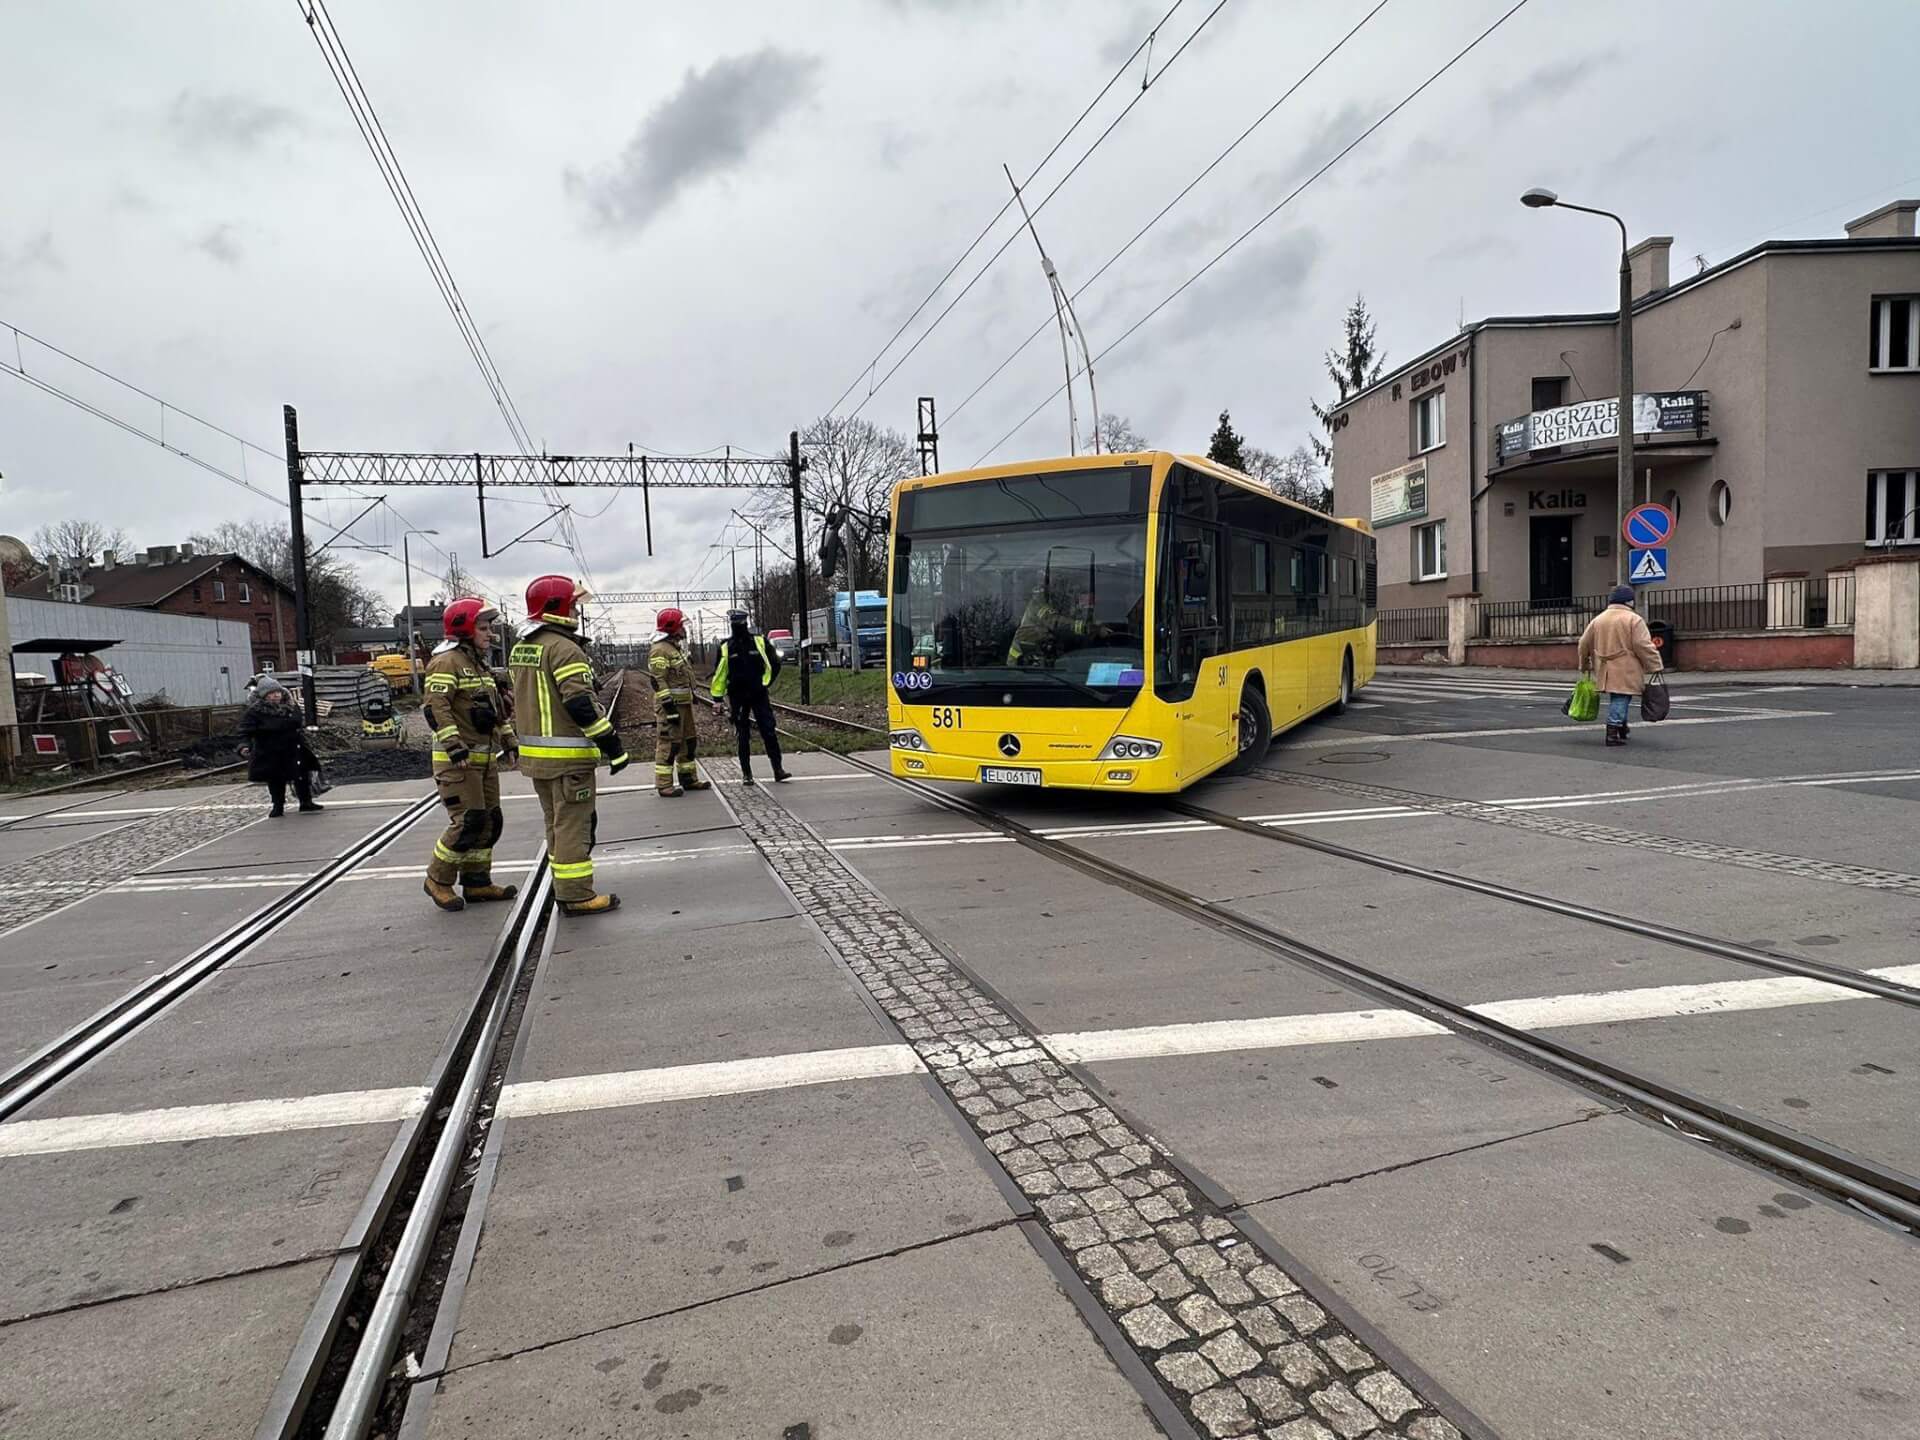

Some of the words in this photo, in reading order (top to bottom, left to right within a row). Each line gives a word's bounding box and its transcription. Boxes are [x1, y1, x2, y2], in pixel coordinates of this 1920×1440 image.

[1660, 395, 1695, 408] Kalia
[1532, 401, 1619, 431] POGRZEB
[1532, 418, 1618, 446] KREMACJ
[1528, 489, 1587, 510] Kalia
[932, 707, 962, 729] 581
[988, 770, 1003, 782] EL
[1006, 771, 1039, 784] 061TV
